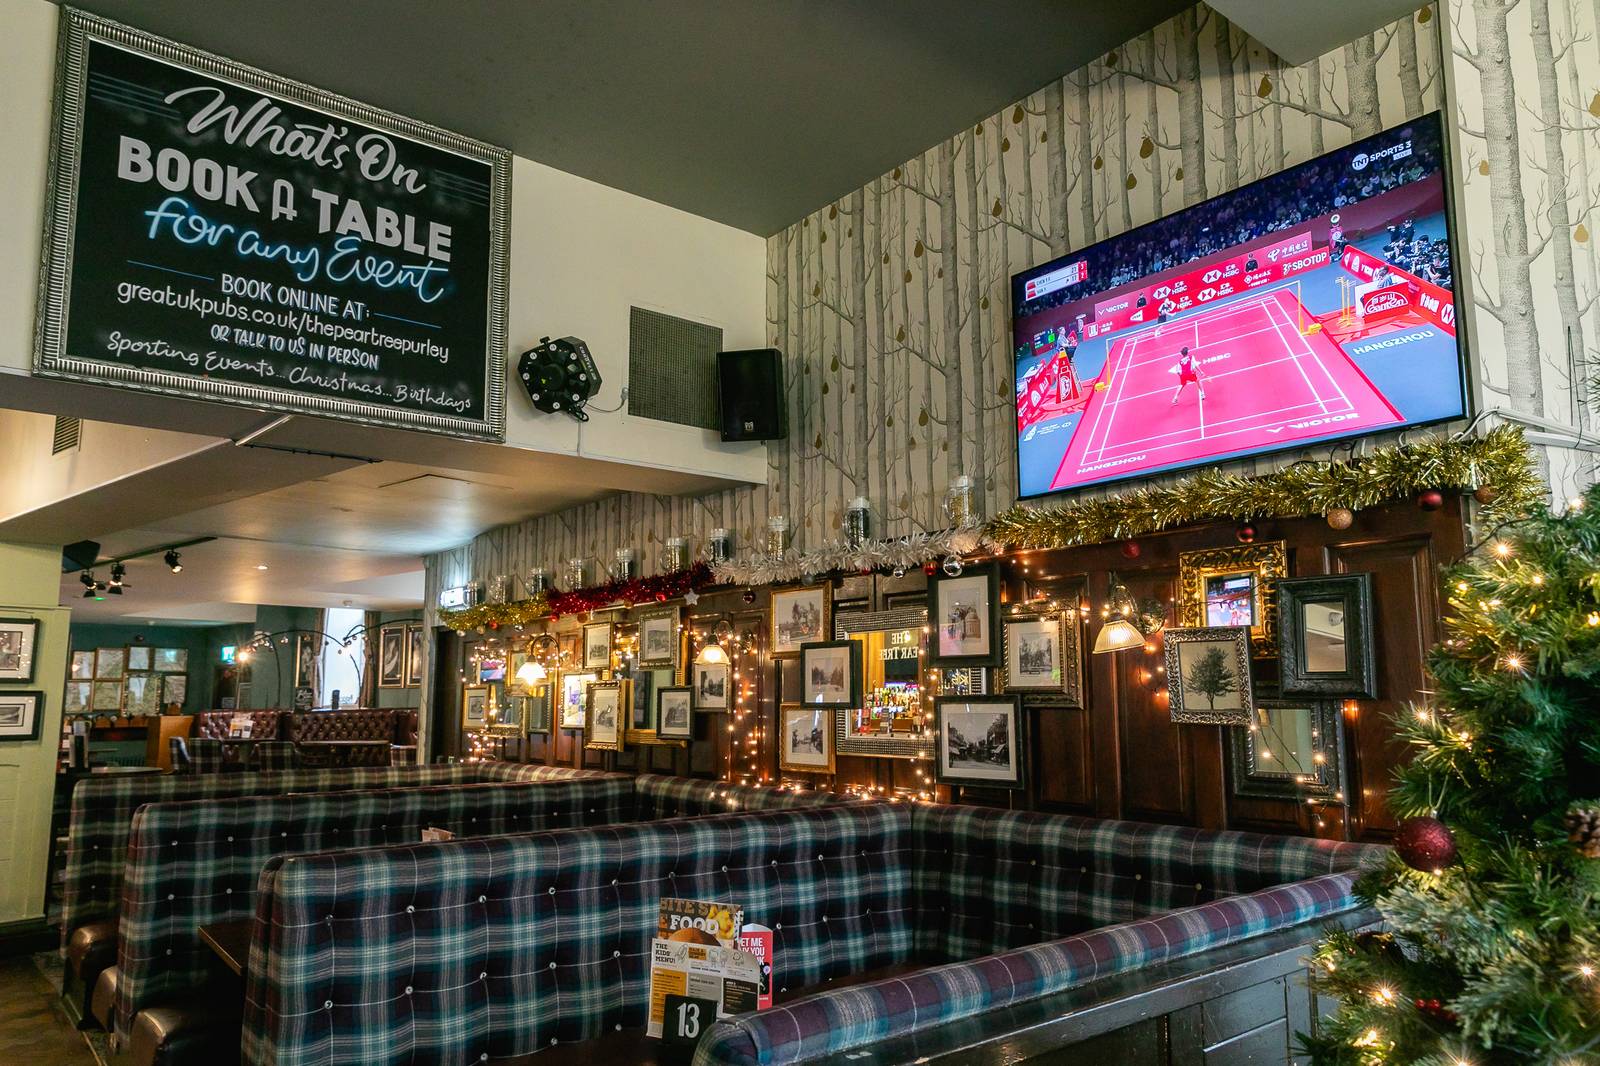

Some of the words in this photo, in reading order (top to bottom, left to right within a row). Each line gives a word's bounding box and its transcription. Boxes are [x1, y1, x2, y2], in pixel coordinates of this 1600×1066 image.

[164, 86, 350, 169] What's
[355, 133, 427, 194] On
[1369, 143, 1404, 162] SPORTS
[1405, 140, 1412, 148] 3
[117, 134, 260, 213] BOOK
[271, 178, 298, 222] A
[311, 188, 452, 262] TABLE
[145, 196, 235, 246] for
[238, 231, 320, 282] any
[326, 236, 449, 303] Event
[1291, 251, 1328, 271] SBOTOP
[221, 273, 273, 303] BOOK
[277, 286, 339, 316] ONLINE
[342, 299, 371, 321] AT:
[1105, 302, 1129, 313] VICTOR
[117, 281, 450, 364] greatukpubs.co.uk/thepeartreepurley
[210, 323, 230, 343] OR
[233, 327, 266, 349] TALK
[269, 335, 286, 352] TO
[288, 336, 306, 355] US
[309, 342, 324, 360] IN
[327, 345, 380, 371] PERSON
[1353, 330, 1435, 355] HANGZHOU
[107, 330, 199, 366] Sporting
[393, 385, 472, 413] Birthdays
[1287, 413, 1360, 429] VICTOR
[1076, 454, 1147, 475] HANGZHOU
[670, 915, 720, 935] FOOD
[750, 937, 764, 947] ME
[677, 1002, 700, 1039] 13
